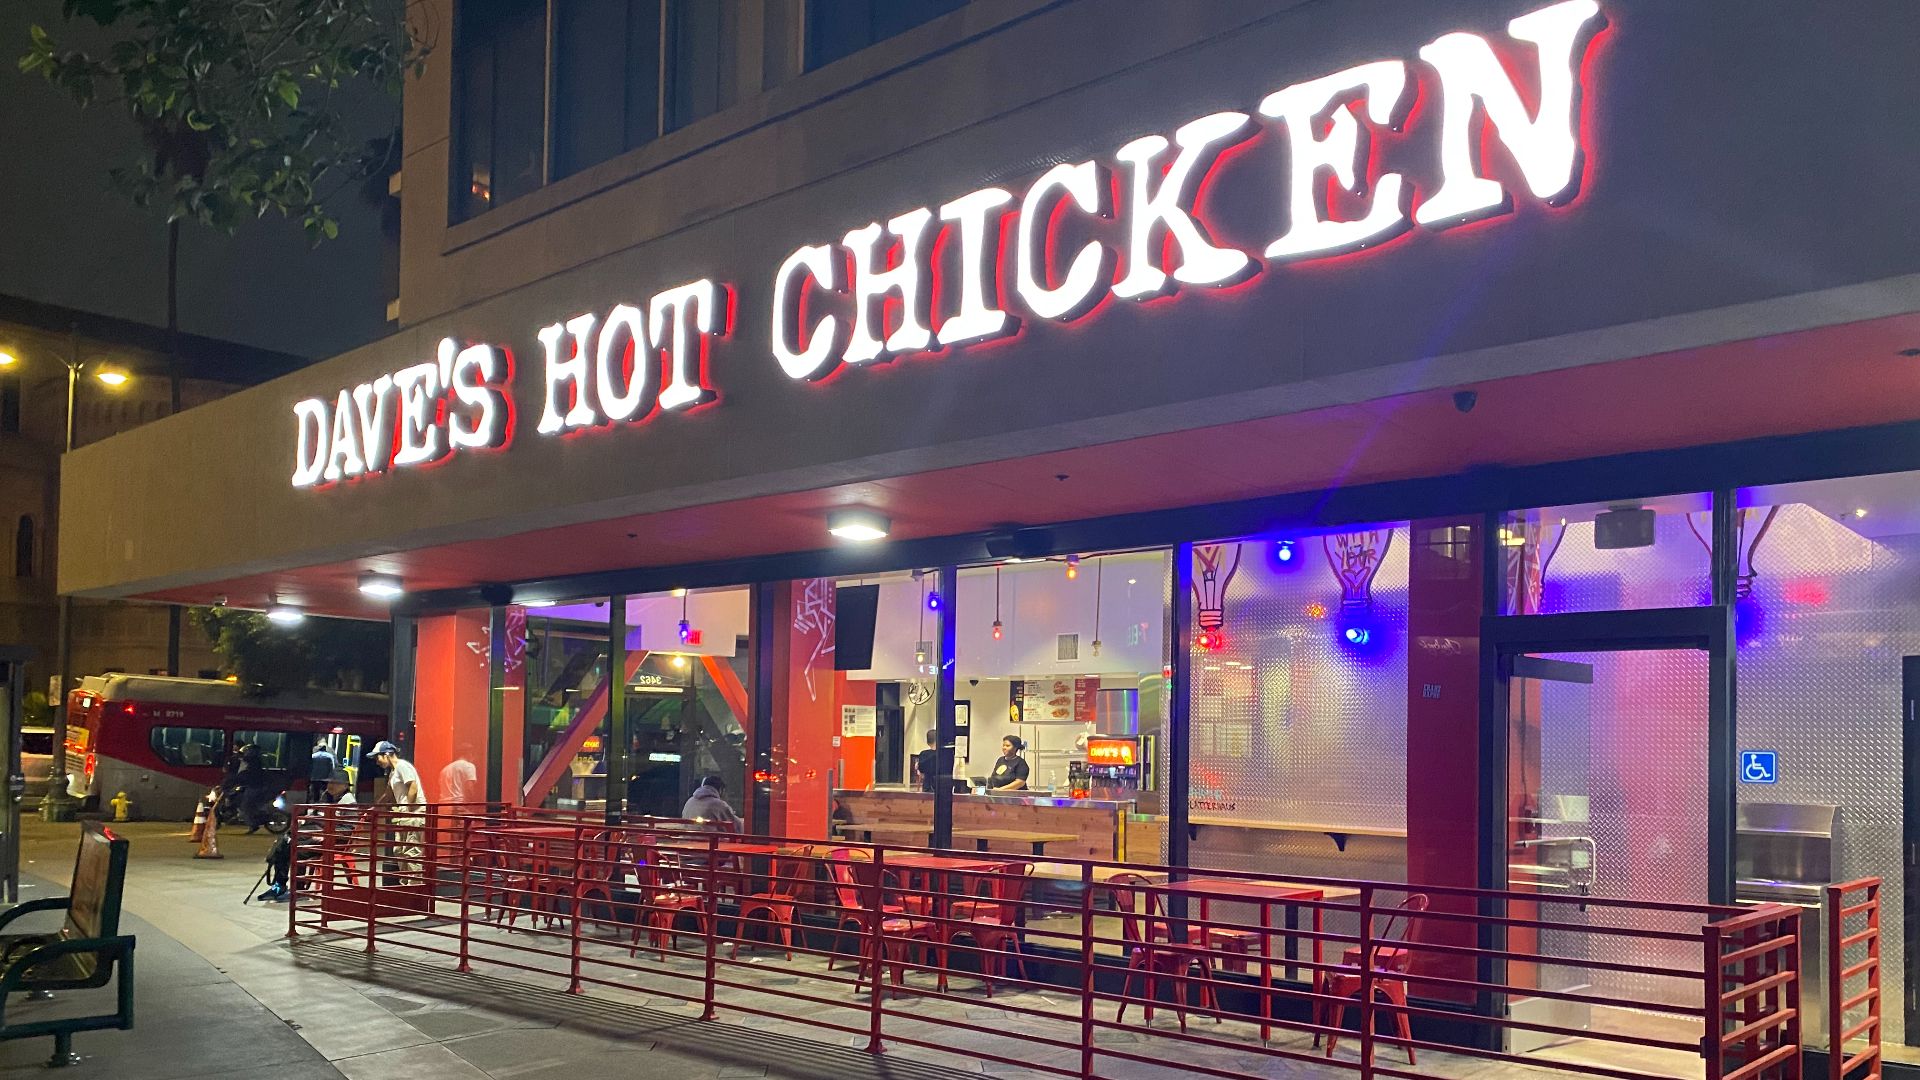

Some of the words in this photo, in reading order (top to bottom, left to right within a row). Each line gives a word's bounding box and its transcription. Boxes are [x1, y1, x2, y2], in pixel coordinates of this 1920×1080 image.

[291, 337, 500, 488] DAVE'S
[536, 279, 718, 436] HOT
[772, 0, 1602, 381] CHICKEN
[1090, 747, 1118, 758] DAVE'S
[1189, 800, 1236, 811] LATTERHAUS
